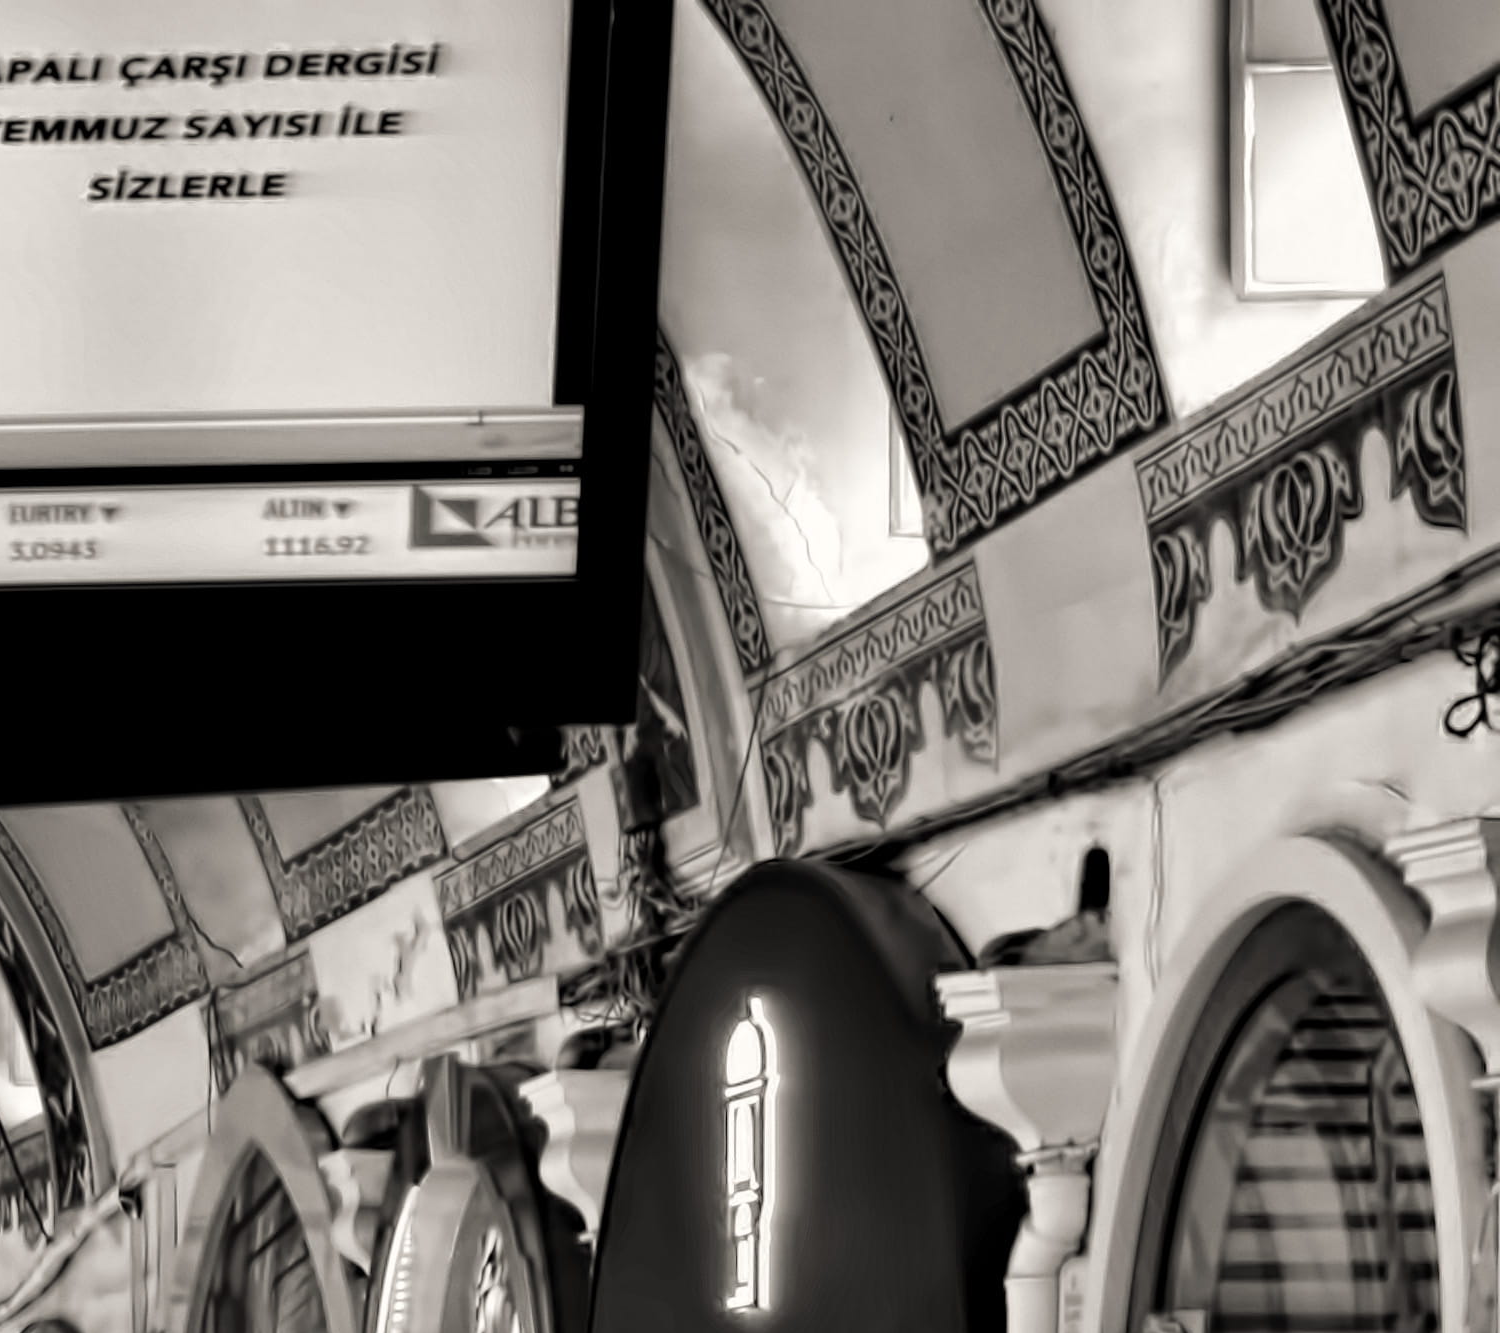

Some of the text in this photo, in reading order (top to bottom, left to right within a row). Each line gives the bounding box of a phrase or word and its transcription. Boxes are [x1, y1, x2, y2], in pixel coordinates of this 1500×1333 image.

[119, 54, 249, 88] ÇARŞI
[263, 43, 444, 79] DERGİSİ
[183, 112, 323, 139] SAYISI
[337, 102, 404, 136] İLE
[86, 166, 287, 201] SİZLERLE
